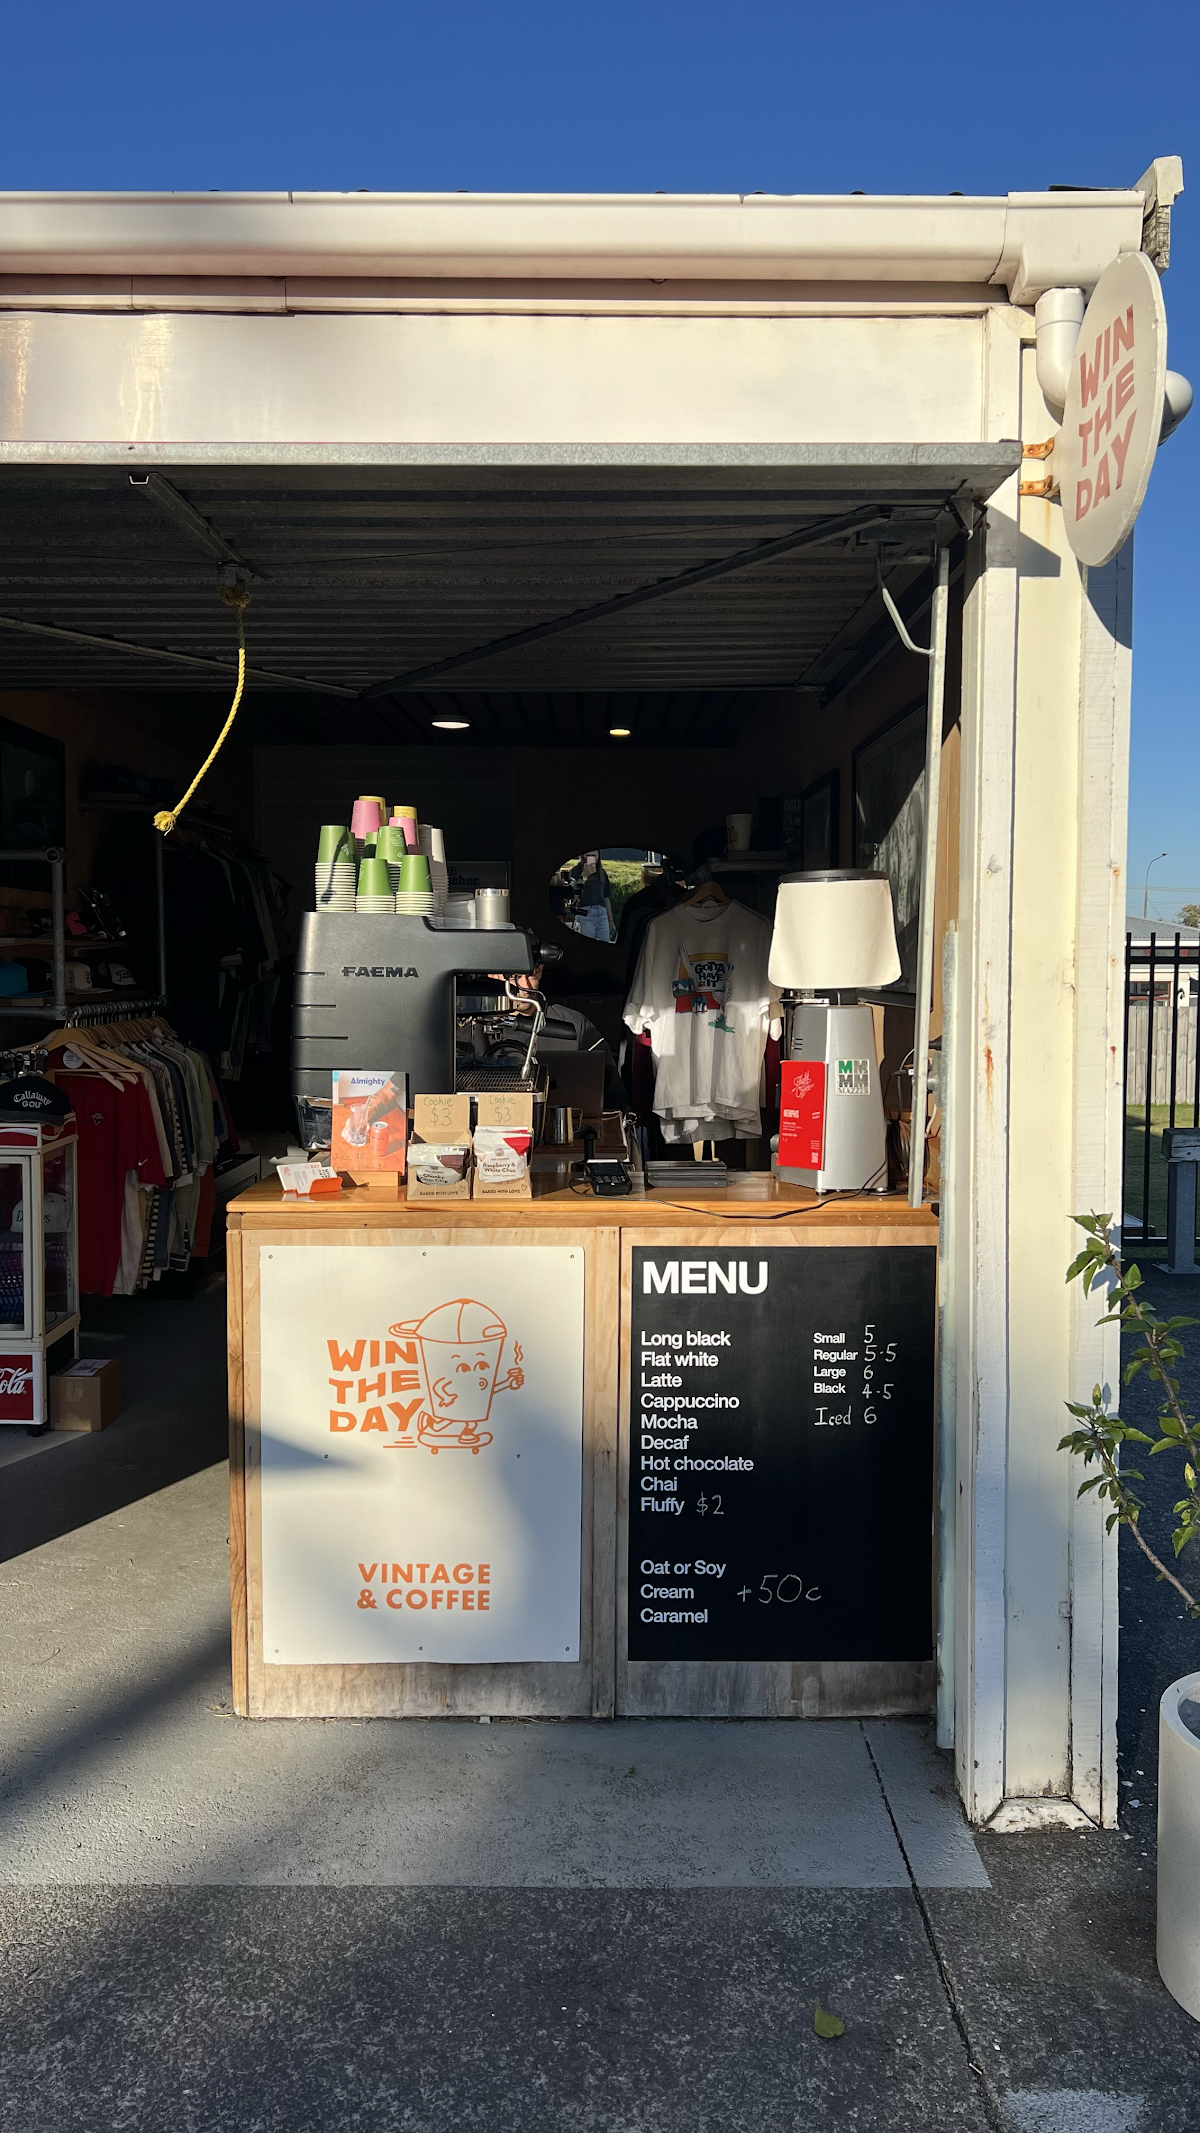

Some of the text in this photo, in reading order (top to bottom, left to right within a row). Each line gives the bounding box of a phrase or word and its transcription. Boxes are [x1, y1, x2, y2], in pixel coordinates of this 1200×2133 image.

[1079, 303, 1135, 409] WIN
[1078, 358, 1135, 467] THE
[1075, 408, 1137, 522] DAY
[341, 966, 419, 978] FAEMA
[694, 961, 725, 974] GOTTA
[699, 972, 723, 981] HAVE
[706, 979, 717, 988] IT
[350, 1077, 386, 1086] Almighty
[13, 1090, 53, 1106] Callaway
[22, 1100, 43, 1109] GOLF
[423, 1096, 454, 1107] Cookie
[489, 1094, 516, 1105] Cookie
[430, 1106, 452, 1127] $3
[494, 1105, 512, 1125] $3
[643, 1261, 769, 1294] MENU
[641, 1331, 731, 1349] Long black
[813, 1324, 876, 1344] Small 5
[327, 1339, 419, 1372] WIN
[641, 1351, 719, 1367] Flat white
[813, 1348, 859, 1362] Regular
[641, 1372, 683, 1388] Latte
[813, 1364, 874, 1380] Large 6
[0, 1367, 28, 1395] ola
[328, 1369, 421, 1404] THE
[813, 1383, 847, 1394] Black
[641, 1393, 740, 1411] Cappuccino
[329, 1397, 426, 1432] DAY
[641, 1414, 698, 1430] Mocha
[813, 1405, 877, 1427] Iced 6
[641, 1435, 689, 1450] Decaf
[641, 1456, 754, 1471] Hot chocolate
[641, 1476, 678, 1491] Chai
[641, 1491, 725, 1517] Fluffy $2
[357, 1563, 490, 1585] VINTAGE
[641, 1560, 727, 1579] Oat or Soy
[357, 1588, 490, 1611] & COFFEE
[641, 1584, 694, 1599] Cream
[641, 1608, 708, 1623] Caramel
